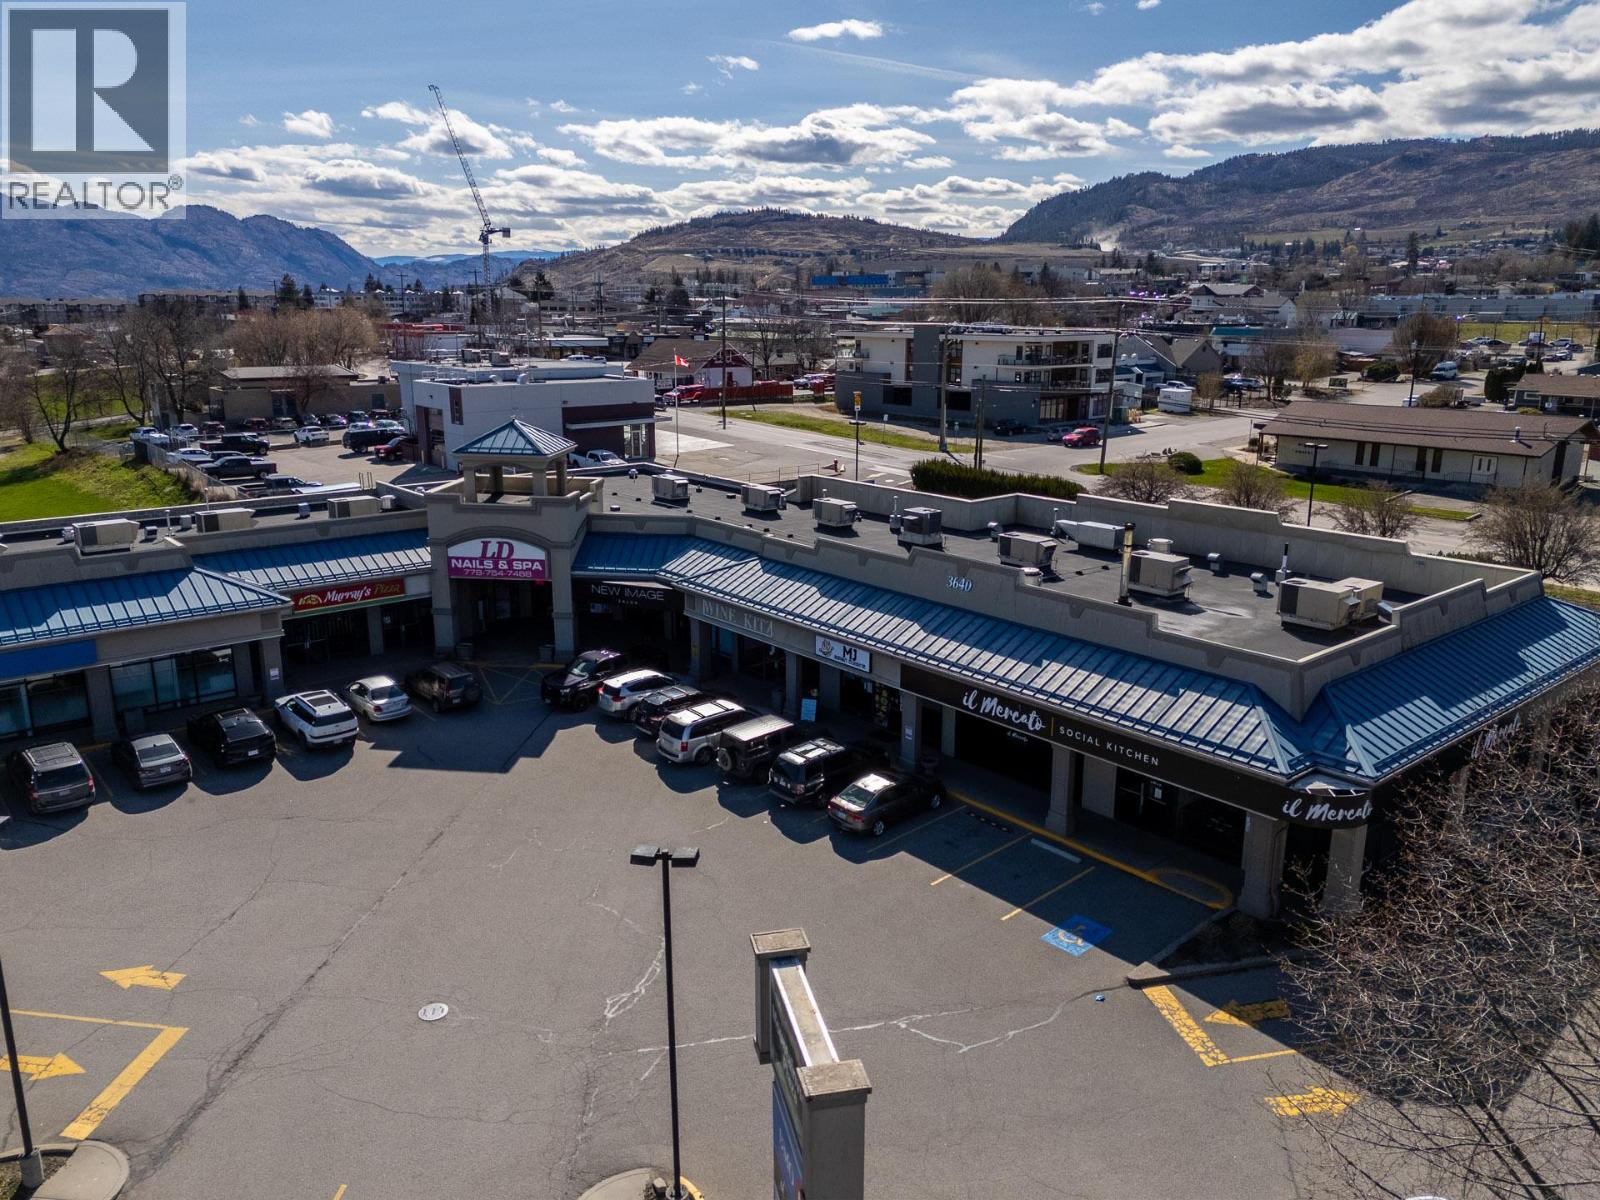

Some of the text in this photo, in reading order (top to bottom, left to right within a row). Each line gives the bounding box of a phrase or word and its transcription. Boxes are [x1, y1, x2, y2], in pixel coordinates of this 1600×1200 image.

[480, 540, 515, 559] LD
[451, 558, 542, 571] NAILS & SPA
[323, 583, 400, 602] Murray's Pizza
[591, 584, 665, 601] NEW IMAGE
[946, 575, 972, 592] 3640
[843, 645, 857, 661] MJ
[962, 690, 1159, 766] il Mercato SOCIAL KITCHEN
[1282, 798, 1302, 817] il
